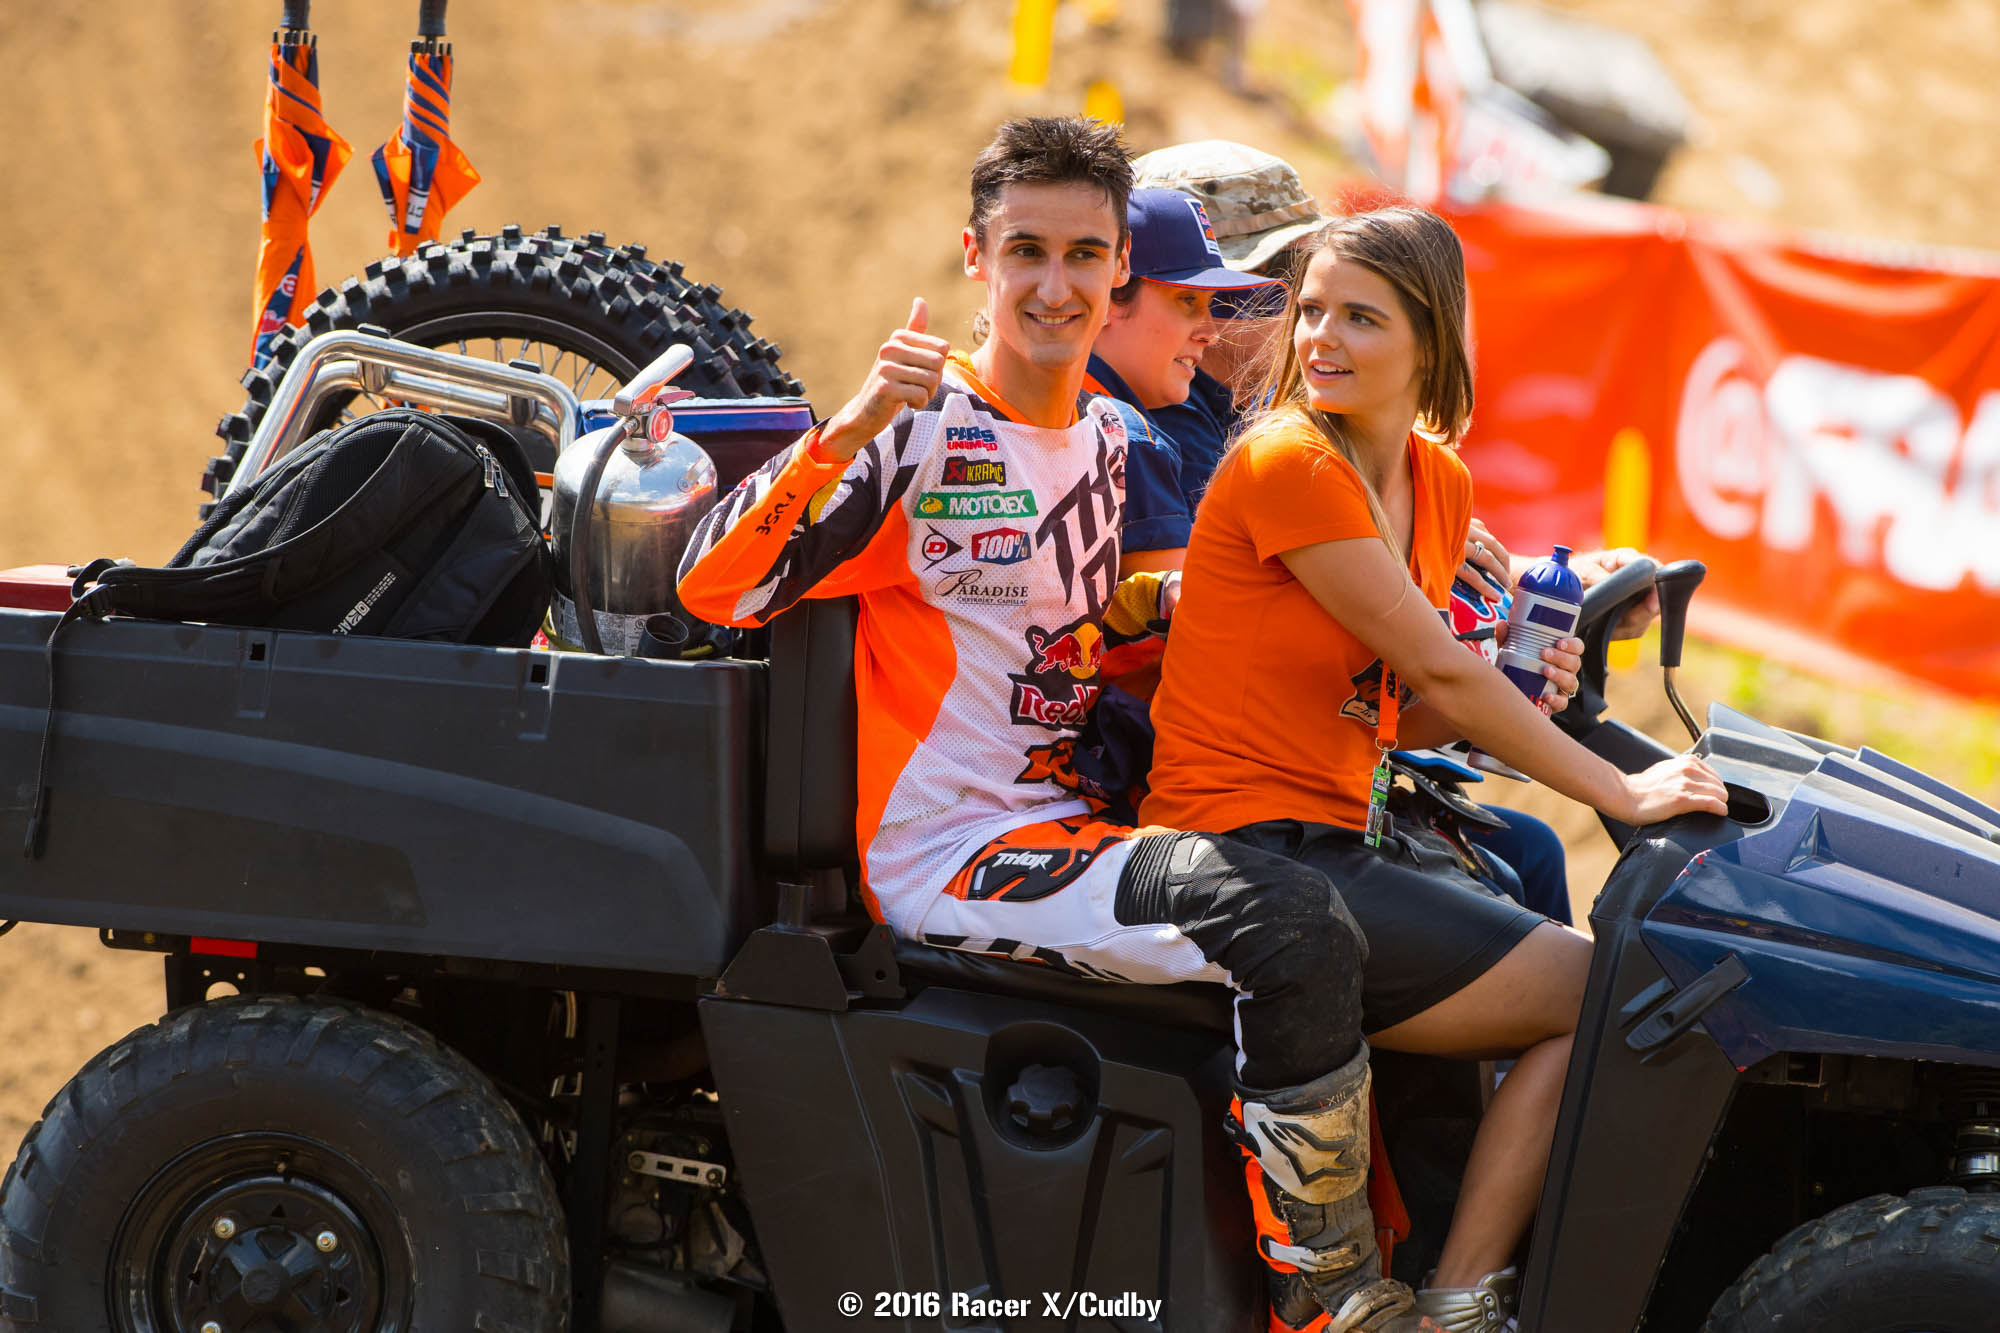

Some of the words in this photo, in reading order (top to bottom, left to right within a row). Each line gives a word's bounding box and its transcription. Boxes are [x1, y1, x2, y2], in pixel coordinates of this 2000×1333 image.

[946, 426, 997, 442] PARS
[977, 534, 1029, 559] 100%
[934, 569, 1029, 598] PARADISE
[1016, 682, 1088, 725] Red
[991, 850, 1054, 871] THOR
